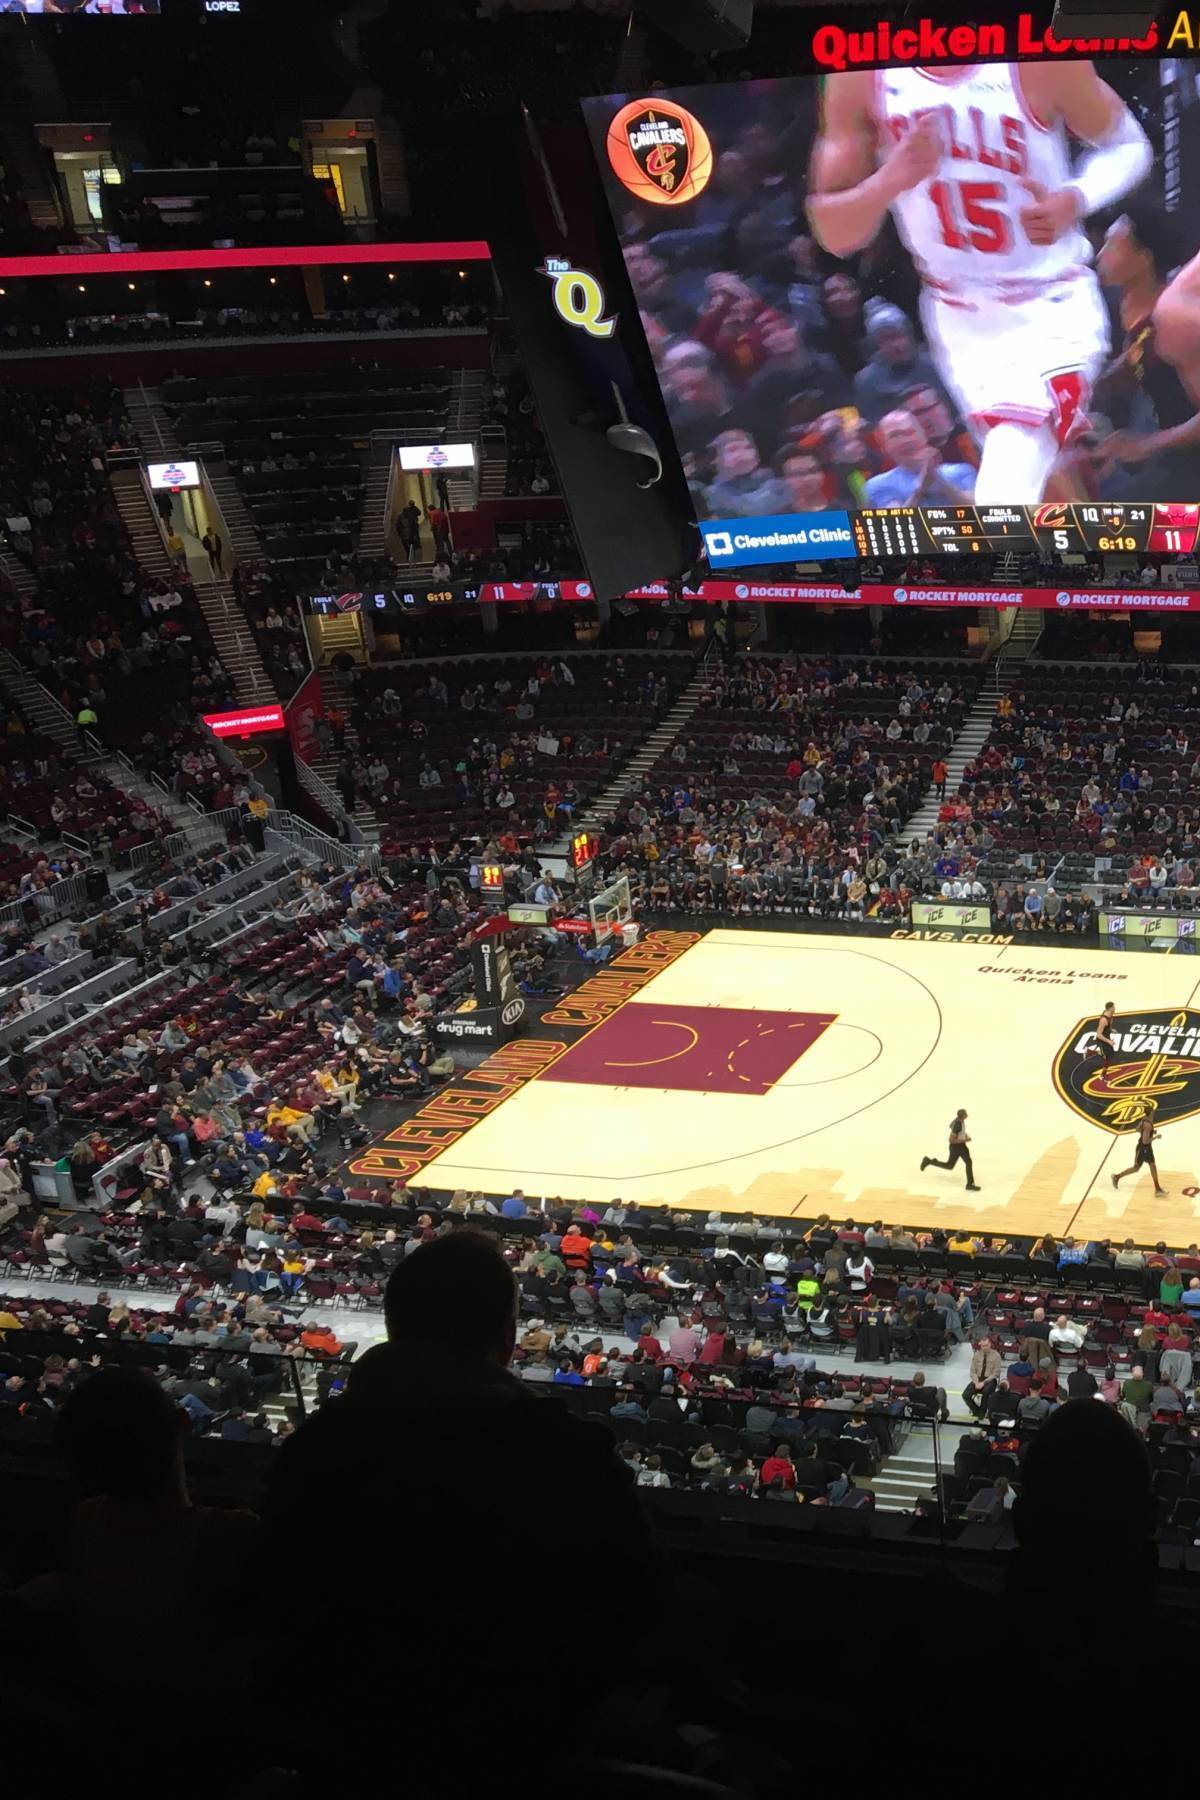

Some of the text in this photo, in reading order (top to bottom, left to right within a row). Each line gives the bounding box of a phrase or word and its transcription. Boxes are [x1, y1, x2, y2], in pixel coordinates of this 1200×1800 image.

[205, 1, 241, 12] LOPEZ
[812, 18, 1007, 68] Quicken
[640, 121, 669, 131] CLEVELAND
[629, 128, 686, 150] CAVALIERS
[928, 180, 1014, 255] 15
[546, 259, 570, 271] The
[545, 270, 616, 336] Q
[927, 510, 966, 519] FG% 17
[1082, 508, 1100, 522] 1Q
[1130, 510, 1146, 520] 21
[931, 526, 972, 536] 3PT% 50
[1002, 524, 1008, 534] 1
[734, 528, 851, 549] Cleveland Clinic
[1053, 530, 1069, 549] 5
[1099, 537, 1137, 550] 6:19
[1165, 530, 1181, 550] 11
[943, 544, 960, 552] TOL
[426, 591, 453, 602] 6:19
[464, 590, 476, 598] 21
[493, 586, 505, 600] 11
[547, 588, 556, 599] 0
[751, 587, 797, 598] ROCKET
[909, 590, 1024, 603] ROCKET MORTGAGE
[1072, 593, 1190, 606] ROCKET MORTGAGE
[374, 594, 386, 608] 5
[211, 720, 241, 729] ROCKET
[928, 907, 945, 924] ICE
[960, 908, 978, 926] ICE
[1108, 917, 1126, 934] ICE
[1144, 918, 1162, 935] ICE
[1178, 920, 1196, 938] ICE
[890, 928, 1014, 945] CAVS.COM
[540, 930, 701, 1026] CAVALIERS
[978, 965, 1128, 981] Quicken Loans
[1013, 975, 1074, 986] Arena
[504, 1003, 523, 1022] KIA
[436, 1022, 493, 1036] drug mart
[348, 1039, 568, 1177] CLEVELAND
